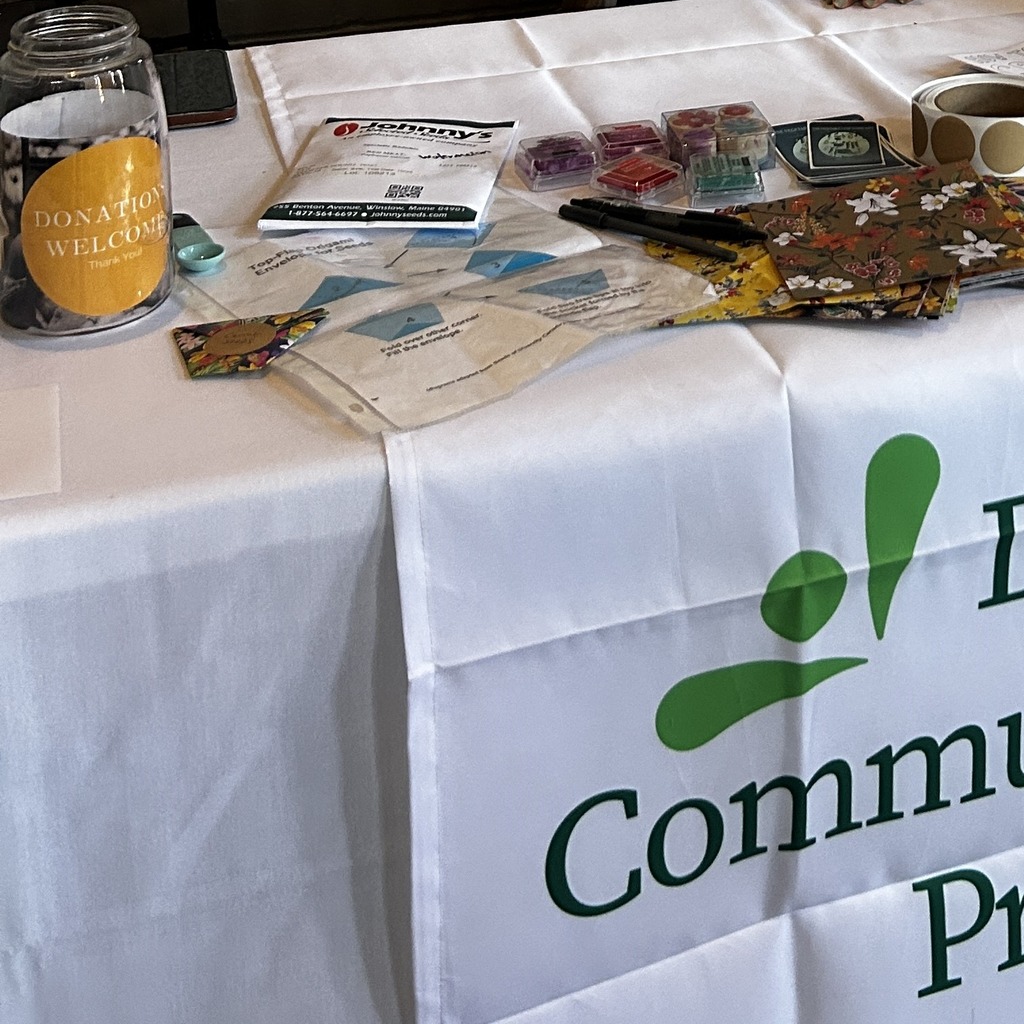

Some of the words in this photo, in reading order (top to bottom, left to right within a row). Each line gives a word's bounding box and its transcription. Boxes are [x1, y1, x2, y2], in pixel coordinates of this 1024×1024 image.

[361, 121, 493, 140] Johnny's
[305, 237, 355, 252] Origami
[335, 241, 375, 252] Seeds
[88, 256, 121, 270] Thank
[123, 247, 143, 261] You!
[404, 335, 425, 345] over
[426, 325, 449, 337] other
[403, 342, 419, 352] the
